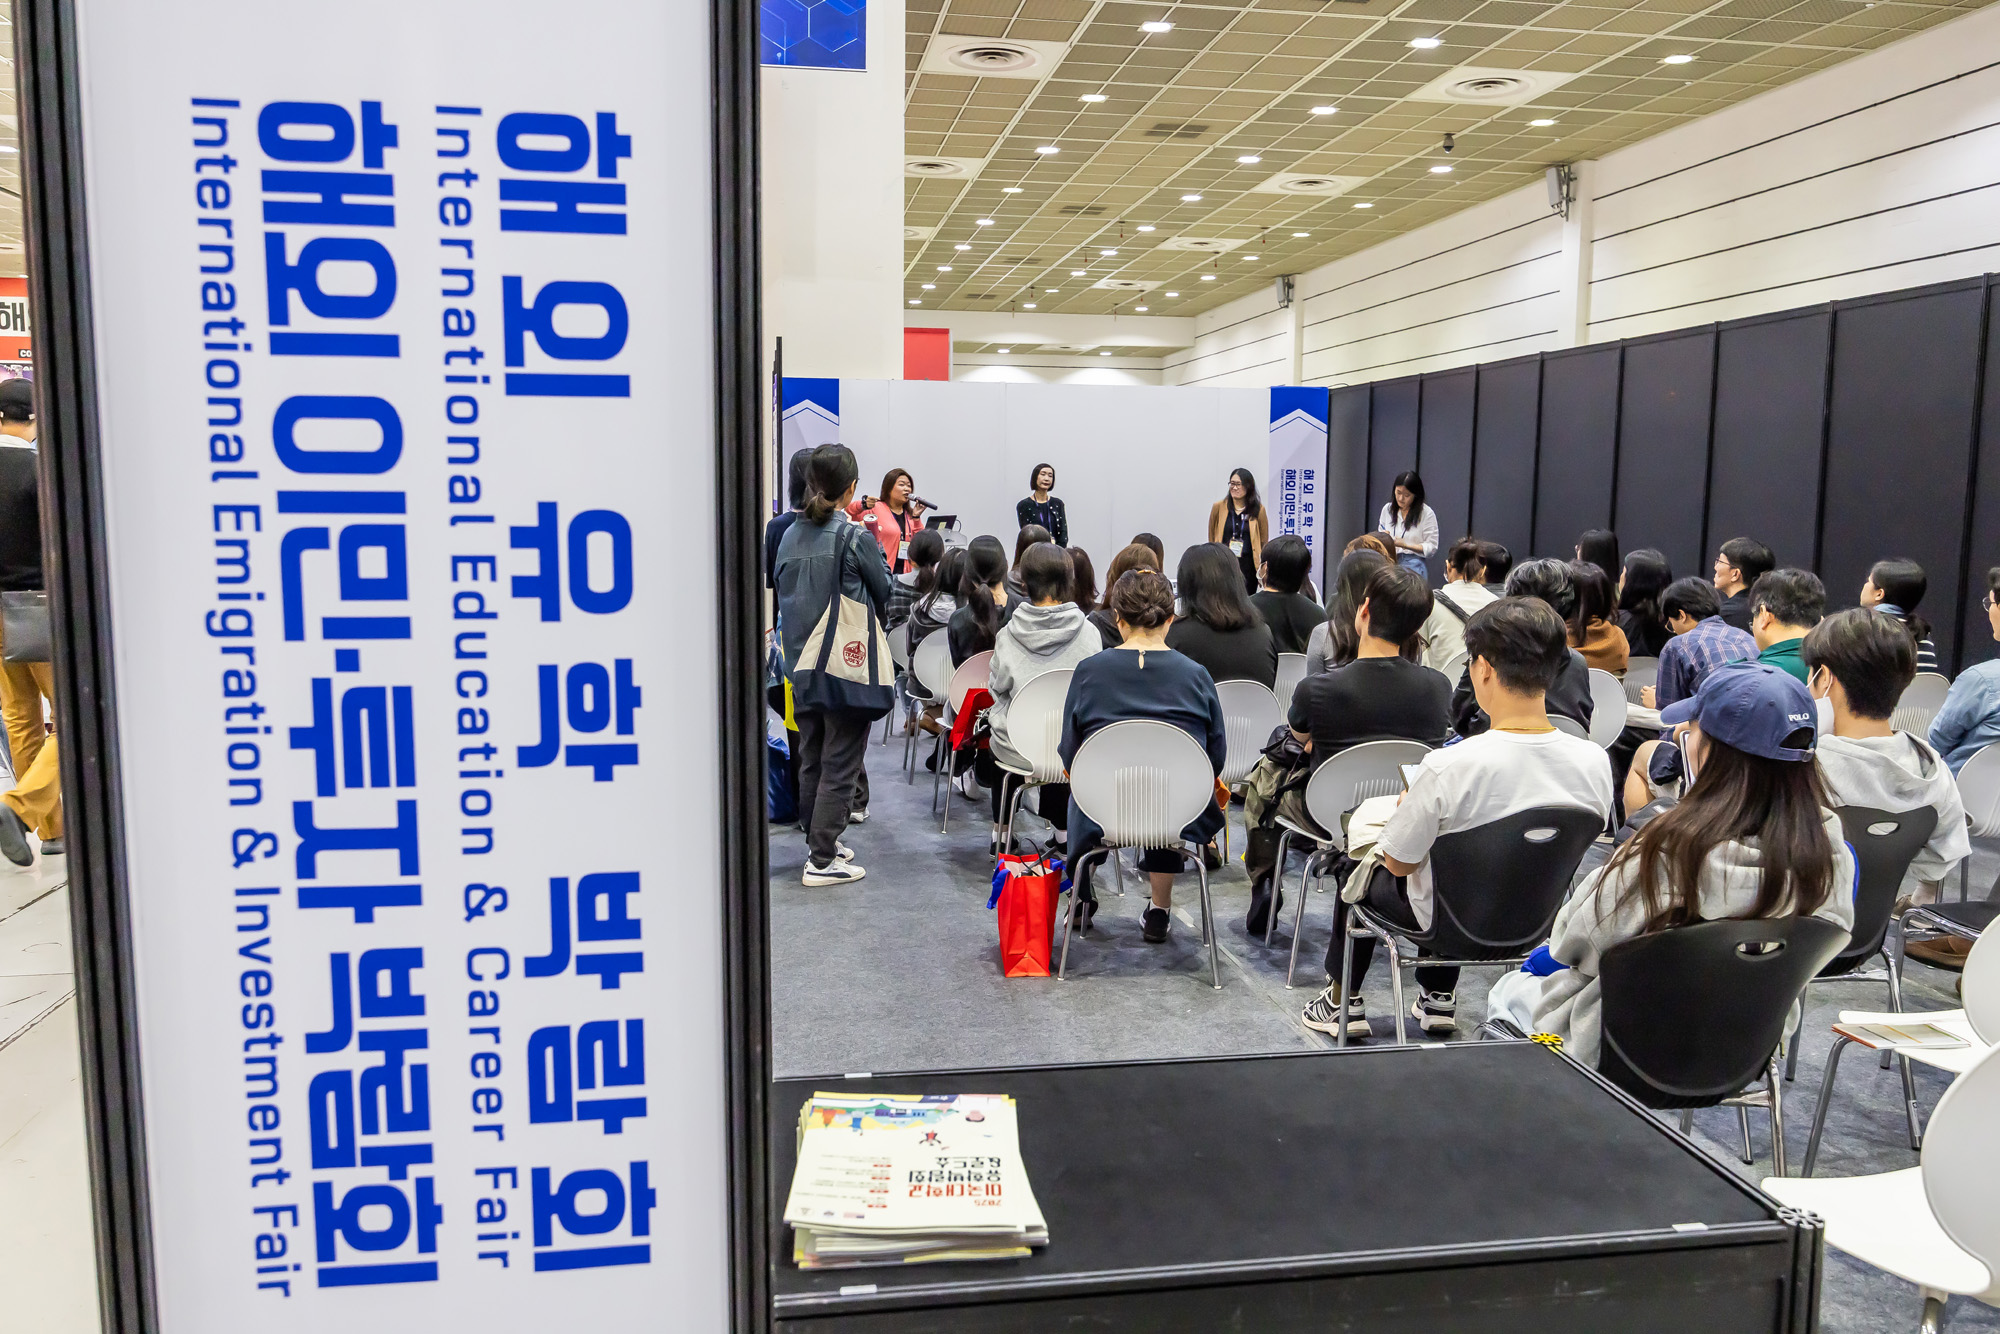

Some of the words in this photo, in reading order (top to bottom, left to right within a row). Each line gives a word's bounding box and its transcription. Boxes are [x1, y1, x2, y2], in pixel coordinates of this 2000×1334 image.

[192, 98, 259, 482] International
[257, 101, 400, 358] 해외
[496, 112, 632, 398] 해외
[0, 302, 31, 332] 해
[435, 106, 495, 526] International
[1285, 469, 1297, 491] 해외
[1302, 502, 1314, 527] 유학
[1303, 469, 1315, 494] 해외
[205, 504, 272, 806] Emigration
[451, 555, 503, 854] Education
[509, 501, 642, 782] 유학
[1788, 713, 1810, 721] POLO
[232, 828, 278, 868] &
[464, 883, 508, 922] &
[235, 887, 291, 1187] Investment
[467, 947, 510, 1141] Career
[524, 872, 656, 1272] 박람회
[305, 947, 443, 1288] 박람회
[908, 1183, 1002, 1198] 미국대학교
[909, 1170, 1001, 1183] 유학박람회
[253, 1205, 301, 1297] Fair
[475, 1167, 519, 1268] Fair
